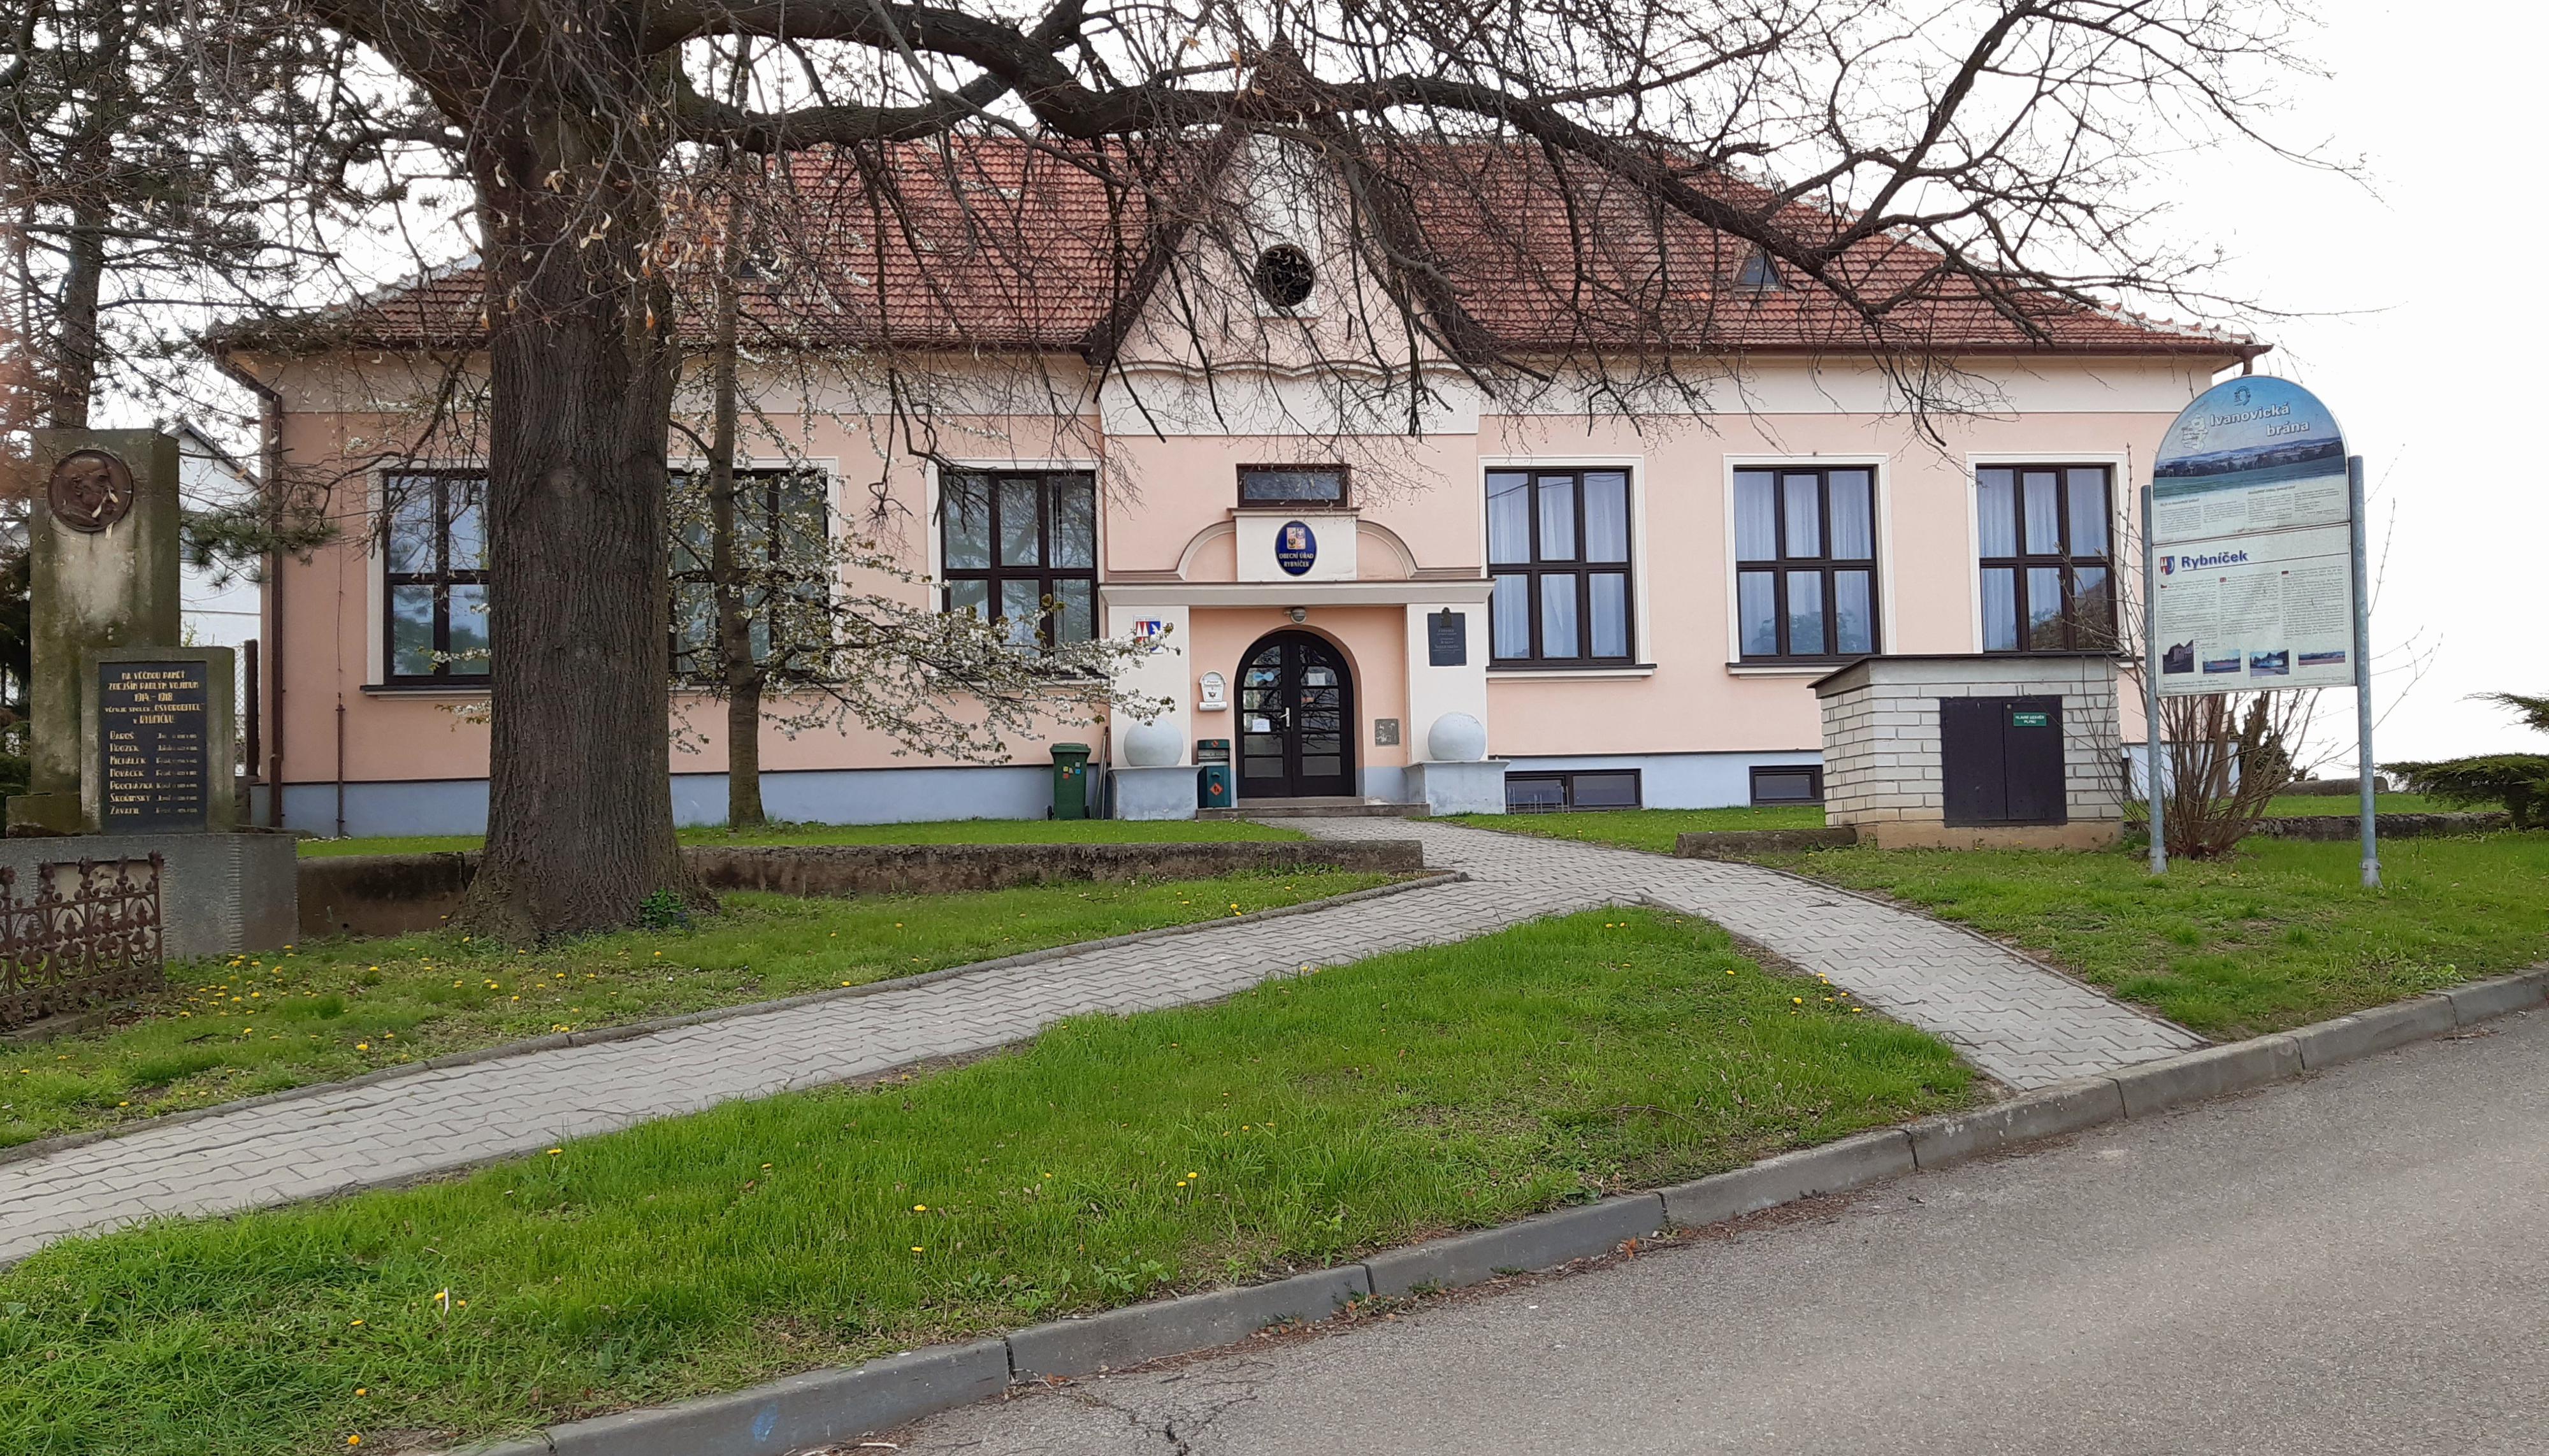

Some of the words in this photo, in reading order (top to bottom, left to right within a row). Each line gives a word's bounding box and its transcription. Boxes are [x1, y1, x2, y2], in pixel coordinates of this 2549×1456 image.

[2209, 401, 2290, 427] Ivanovická
[2266, 420, 2309, 436] brána
[2181, 551, 2249, 572] Rybníček
